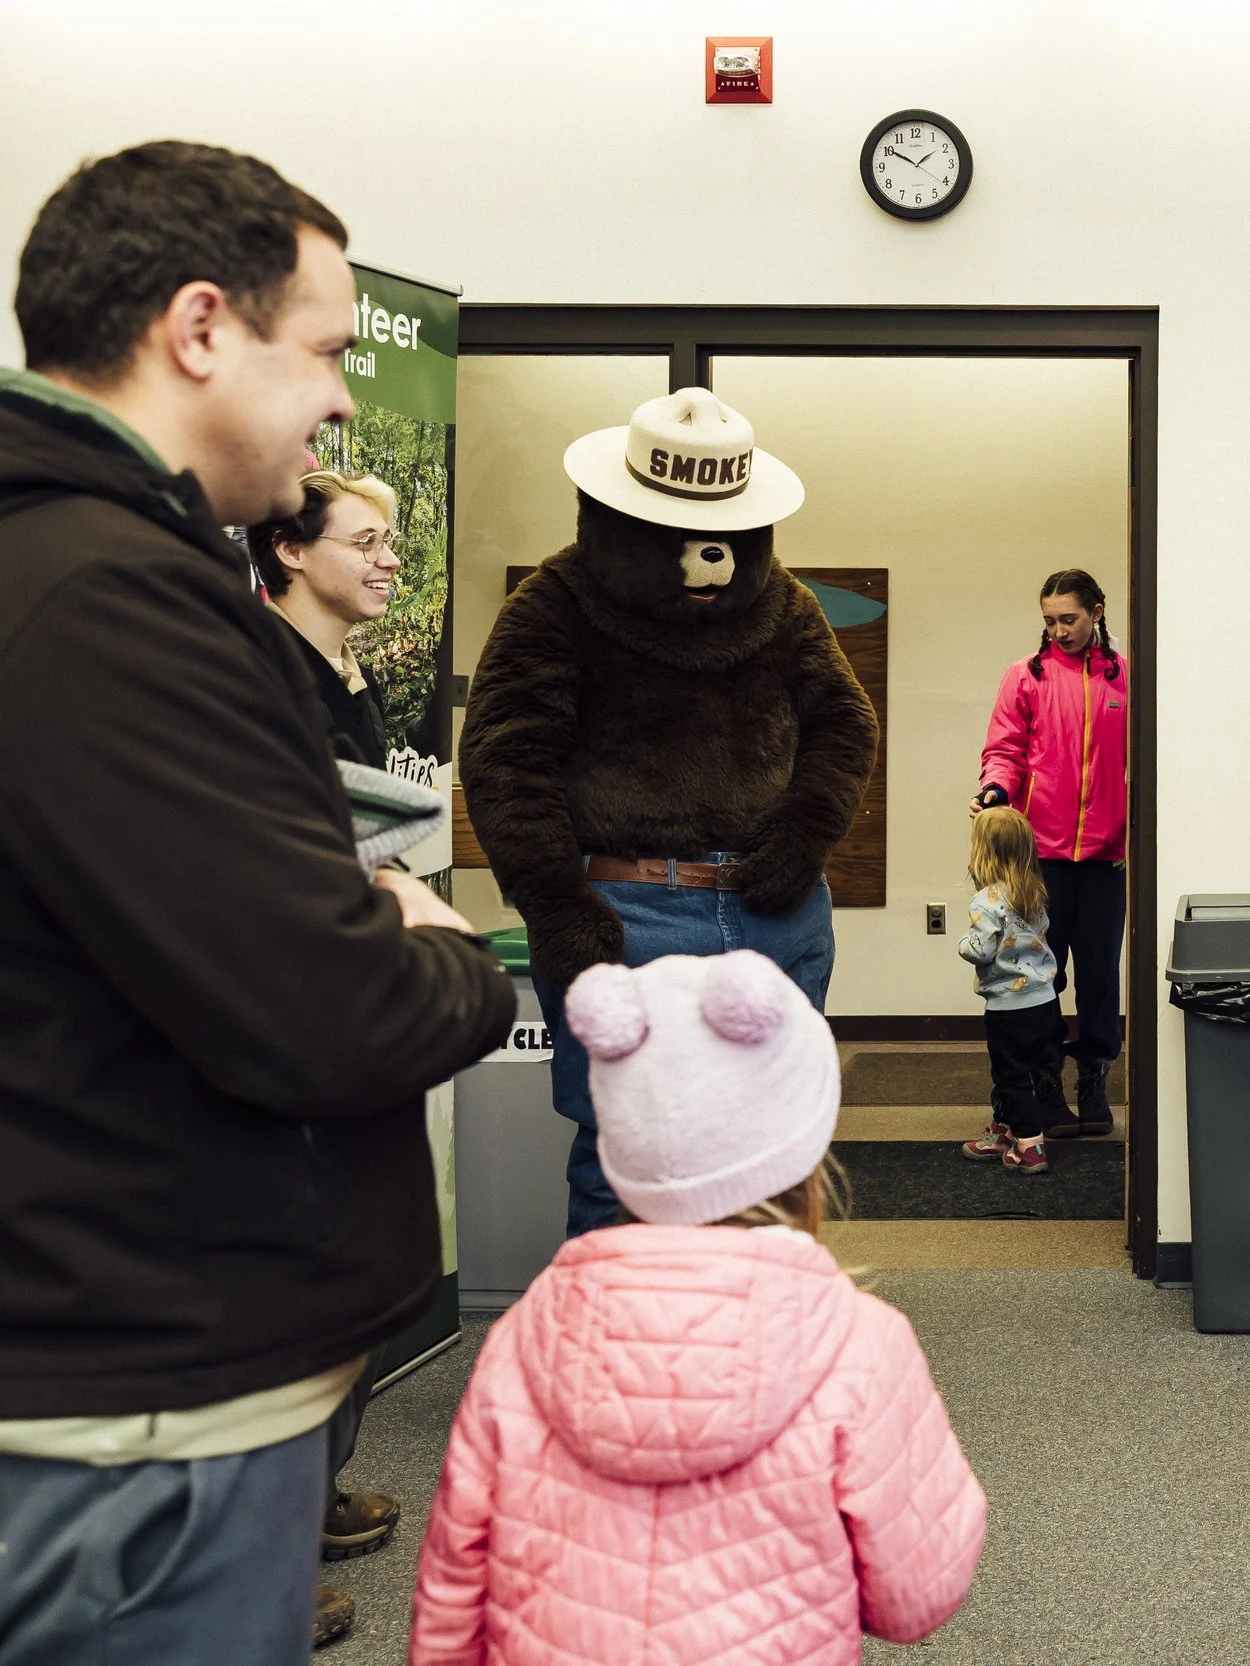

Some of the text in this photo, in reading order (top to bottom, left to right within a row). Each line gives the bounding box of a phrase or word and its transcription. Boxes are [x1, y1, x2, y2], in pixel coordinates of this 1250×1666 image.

[910, 128, 921, 138] 12
[931, 132, 936, 142] 1
[895, 133, 904, 144] 11
[883, 146, 895, 156] 10
[942, 143, 949, 153] 2
[878, 162, 886, 173] 9
[948, 159, 955, 169] 3
[885, 179, 892, 189] 8
[942, 176, 949, 186] 4
[899, 190, 905, 200] 7
[915, 193, 922, 204] 6
[931, 188, 938, 199] 5
[344, 348, 376, 378] Trail
[650, 447, 752, 486] SMOKE
[501, 1028, 553, 1050] CLE
